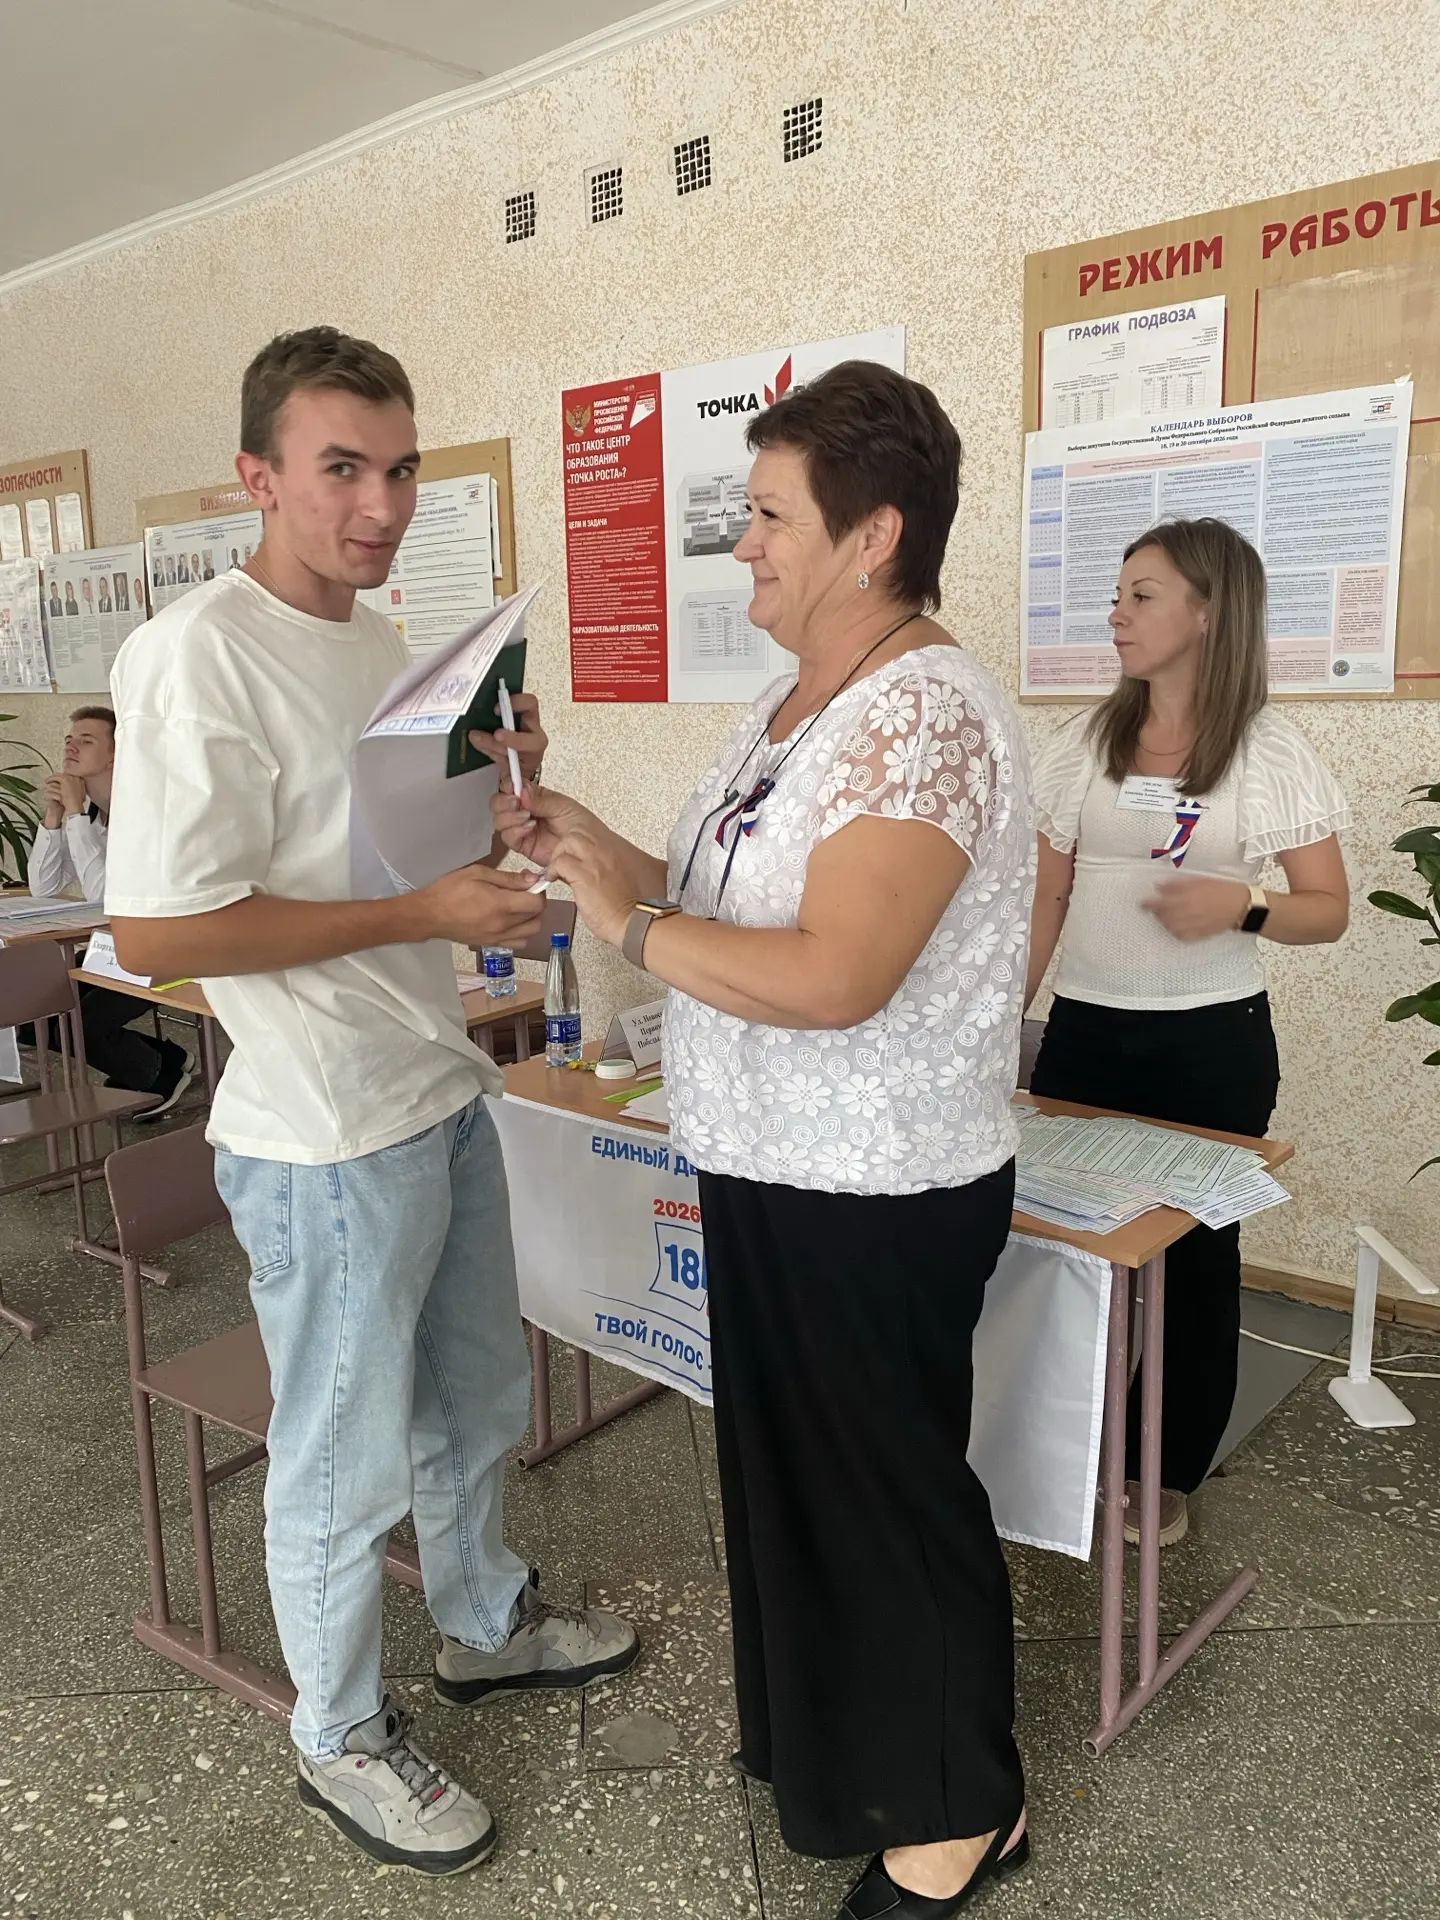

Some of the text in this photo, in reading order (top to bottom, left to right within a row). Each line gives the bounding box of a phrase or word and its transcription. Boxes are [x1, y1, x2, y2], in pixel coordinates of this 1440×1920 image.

[1079, 236, 1223, 297] РЕЖИМ
[1068, 307, 1196, 341] ГРАФИК ПОДВОЗА
[697, 393, 759, 419] ТОЧКА
[1151, 414, 1253, 433] КАЛЕНДАРЬ ВЫБОРОВ
[566, 435, 631, 454] ЧТО ТАКОЕ ЦЕНТР
[566, 452, 619, 470] ОБРАЗОВАНИЯ
[569, 518, 608, 529] ЦЕЛИ И ЗАДАЧИ
[572, 624, 659, 634] ОБРАЗОВАТЕЛЬНАЯ ДЕЯТЕЛЬНОСТЬ
[592, 1136, 669, 1170] ЕДИНЫЙ
[653, 1199, 701, 1223] 2026
[664, 1244, 700, 1290] 18
[595, 1313, 704, 1370] ТВОЙ ГОЛОС
